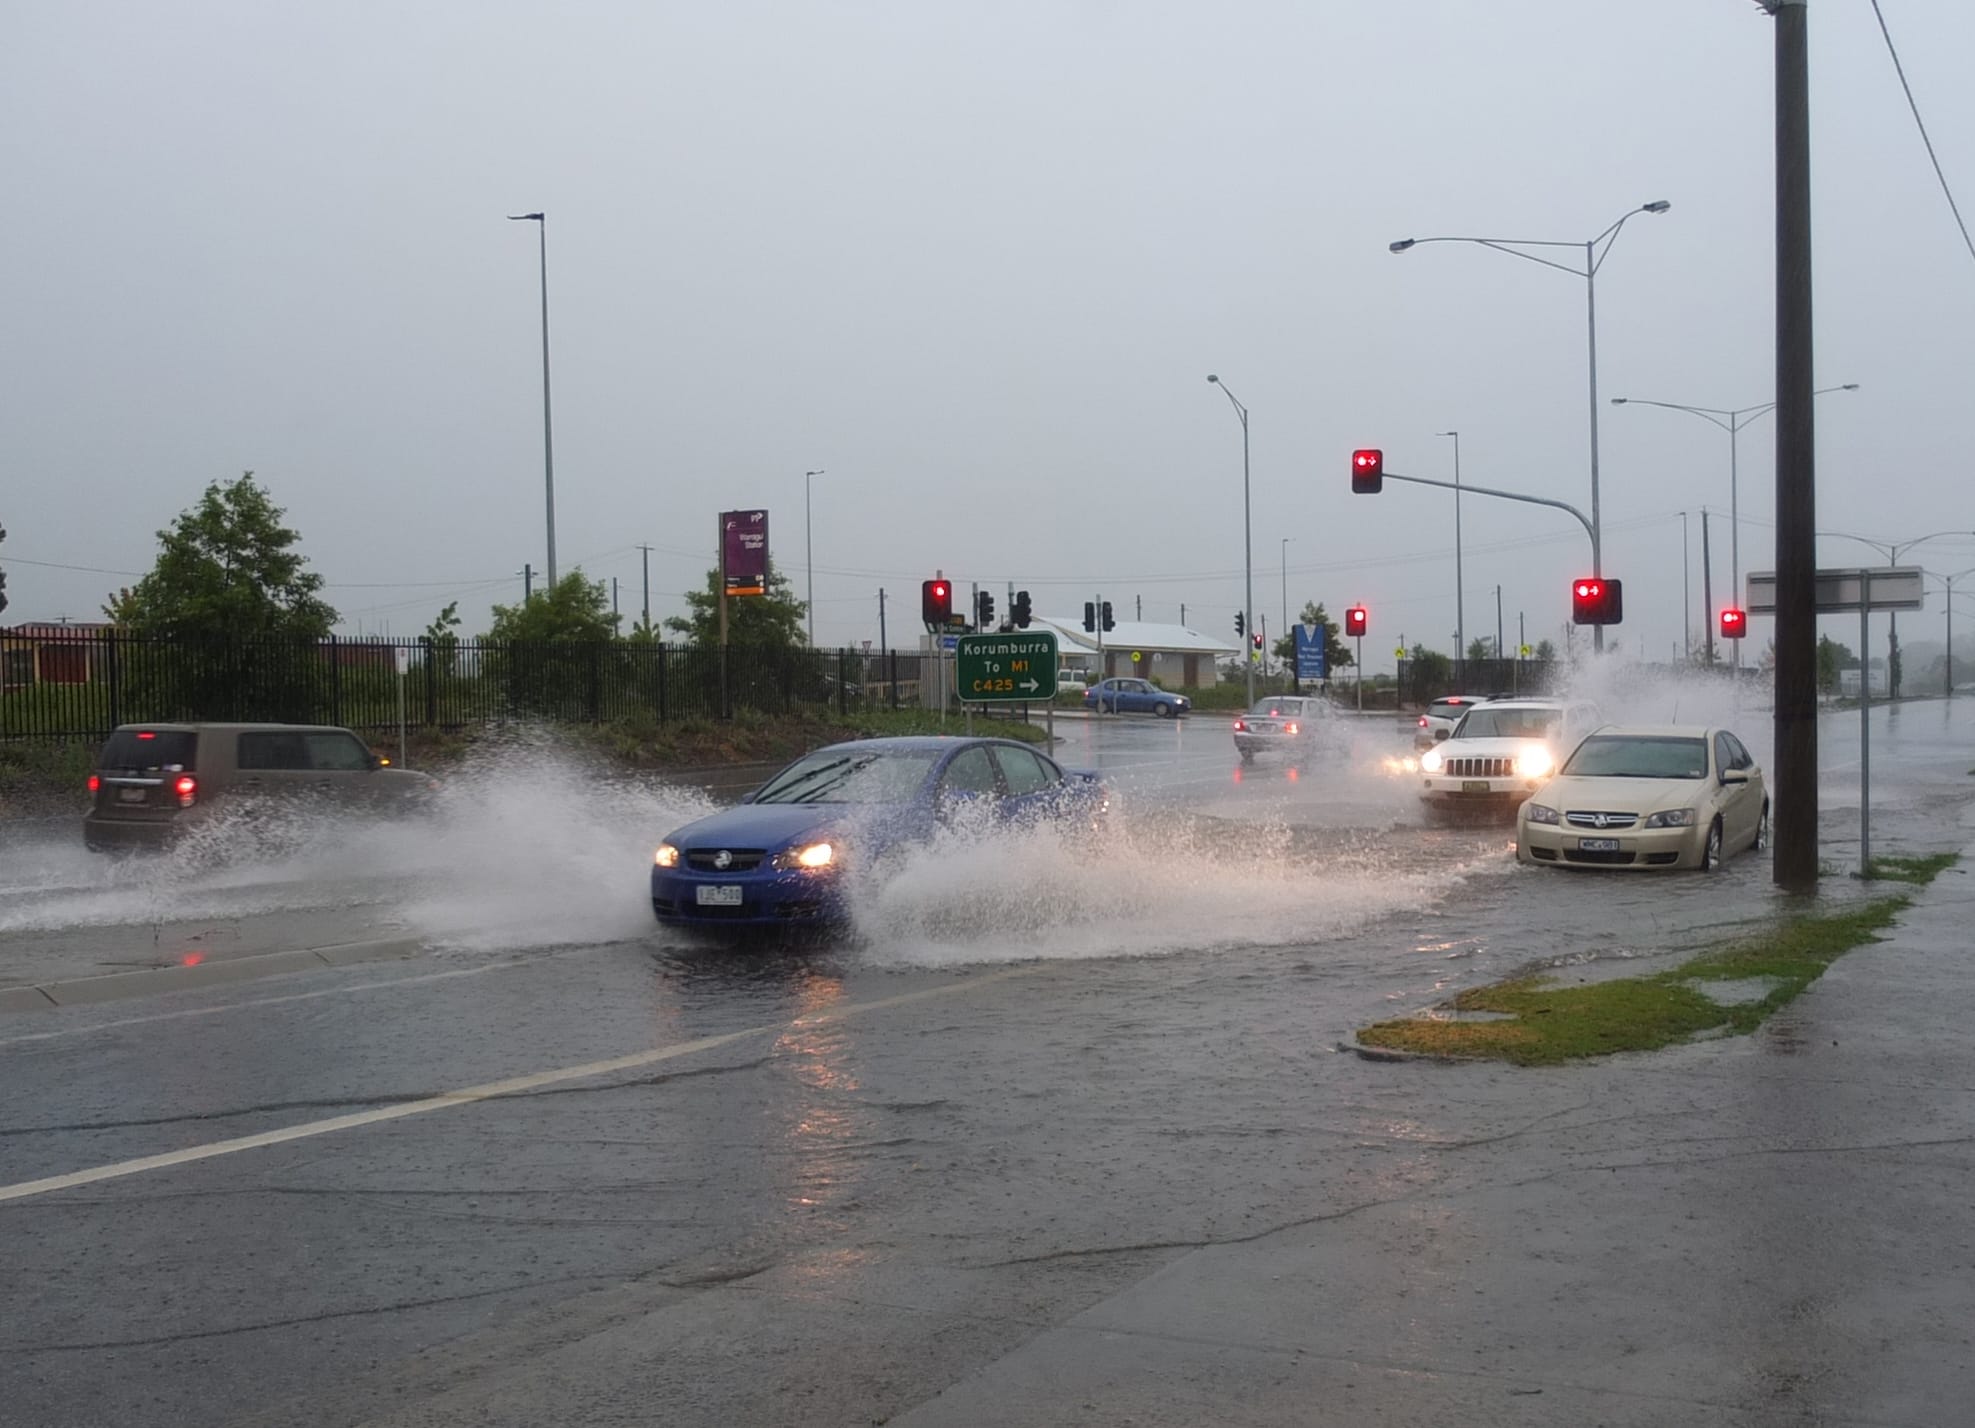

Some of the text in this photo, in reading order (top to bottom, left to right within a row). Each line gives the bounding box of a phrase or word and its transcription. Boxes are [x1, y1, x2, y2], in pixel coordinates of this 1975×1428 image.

[964, 642, 1049, 655] Korumburra
[984, 660, 1029, 673] To M1
[973, 679, 1013, 692] C425
